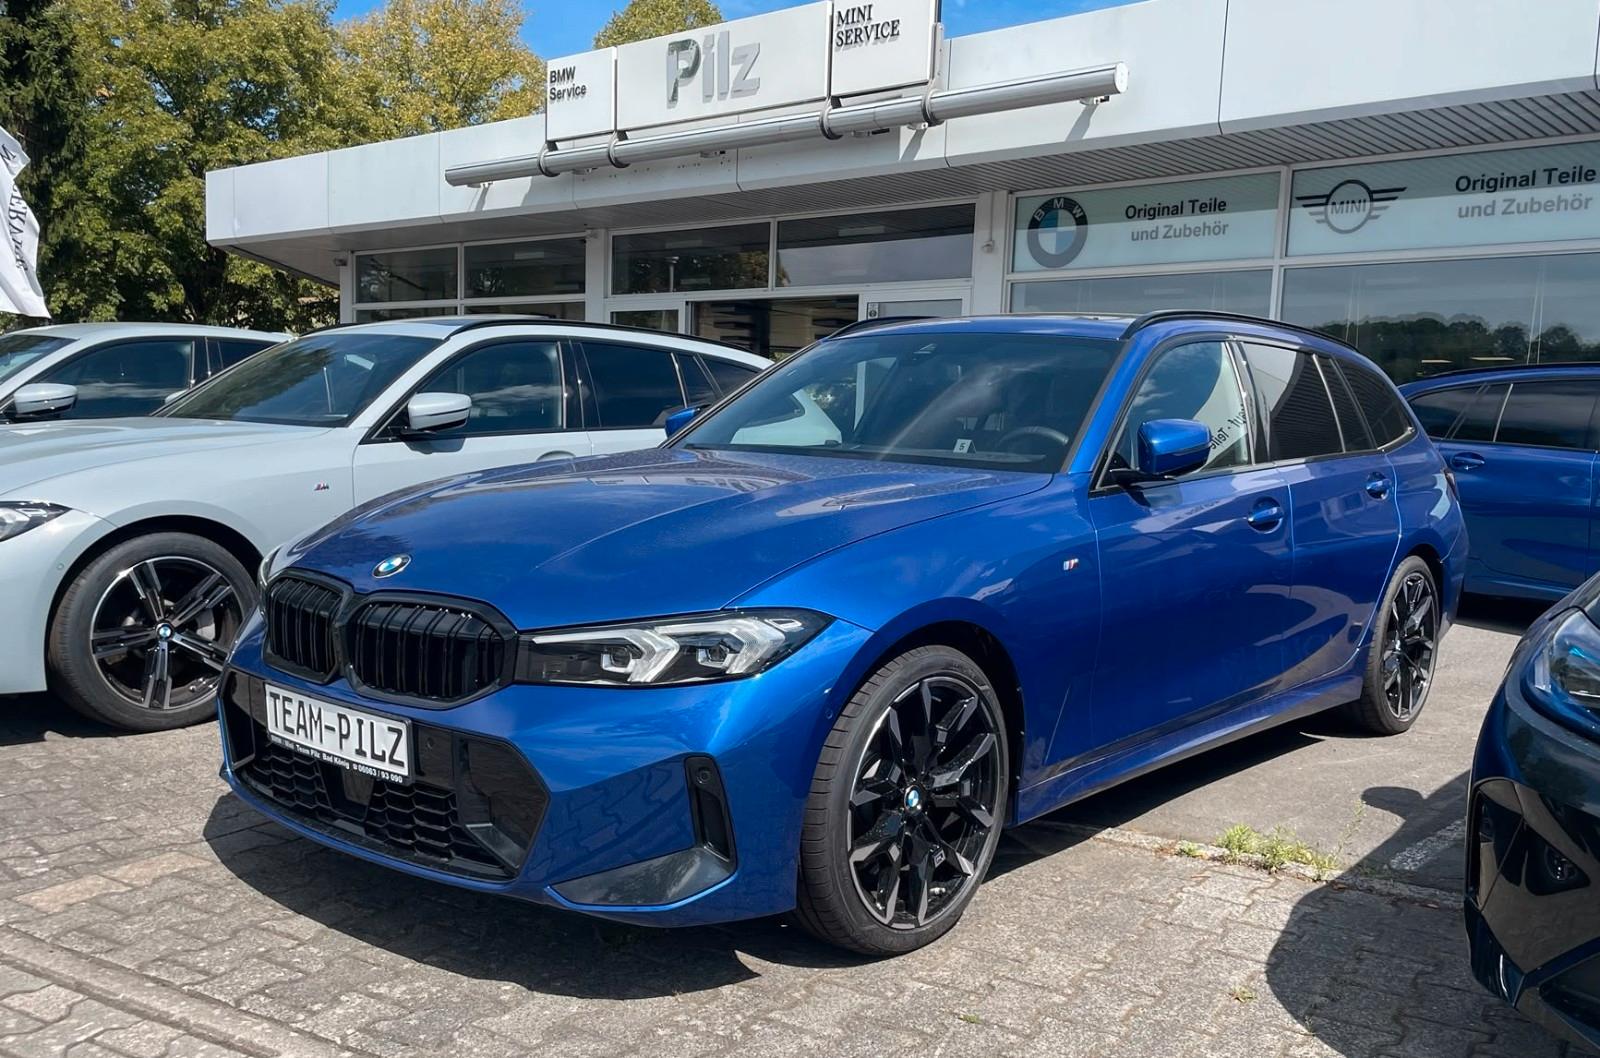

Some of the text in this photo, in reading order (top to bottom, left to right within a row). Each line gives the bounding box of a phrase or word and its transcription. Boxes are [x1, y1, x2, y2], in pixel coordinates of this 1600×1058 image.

[836, 4, 873, 27] MINI
[835, 19, 900, 47] SERVICE
[550, 66, 576, 84] BMW
[667, 30, 760, 109] Pilz
[549, 83, 587, 100] Service
[1455, 165, 1597, 193] Original Teile
[1033, 198, 1084, 221] BMW
[1125, 197, 1227, 220] Original Teile
[1330, 199, 1367, 215] MINI
[1458, 193, 1593, 218] und Zubehör
[1131, 221, 1229, 241] und Zubehör
[269, 691, 405, 768] TEAM-PILZ
